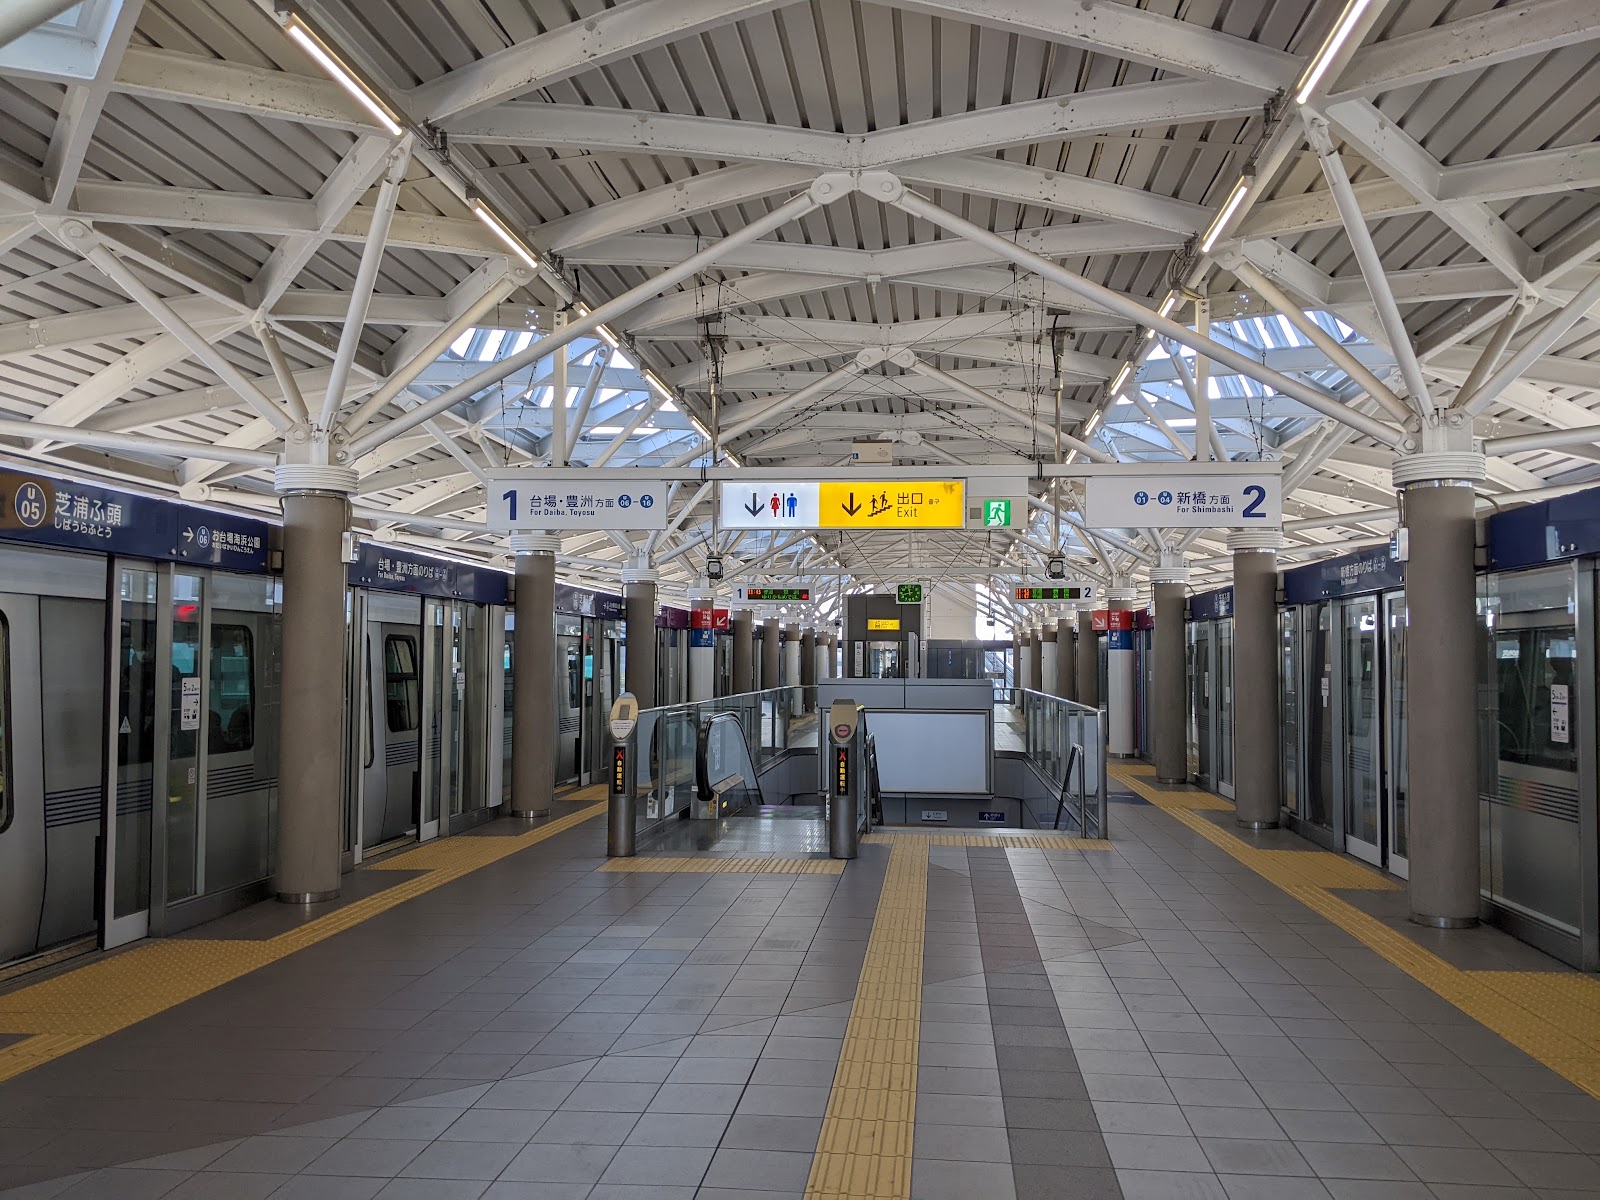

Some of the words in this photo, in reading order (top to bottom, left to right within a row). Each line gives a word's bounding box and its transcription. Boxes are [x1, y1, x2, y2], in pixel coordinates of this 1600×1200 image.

[27, 487, 36, 500] U
[897, 492, 923, 505] 出口
[1177, 491, 1230, 505] 新橋方面
[502, 489, 517, 521] 1
[1242, 484, 1267, 518] 2
[21, 500, 40, 520] 05
[55, 491, 122, 527] 芝浦ふ頭
[544, 509, 567, 517] Daiba,
[570, 509, 595, 517] Toyosu
[897, 506, 918, 518] Exit
[1192, 505, 1234, 513] Shimbashi
[54, 517, 112, 538] しばうらふとう
[199, 535, 208, 545] 06
[212, 529, 261, 549] お台場海浜公園
[737, 588, 742, 599] 1
[1084, 587, 1092, 598] 2
